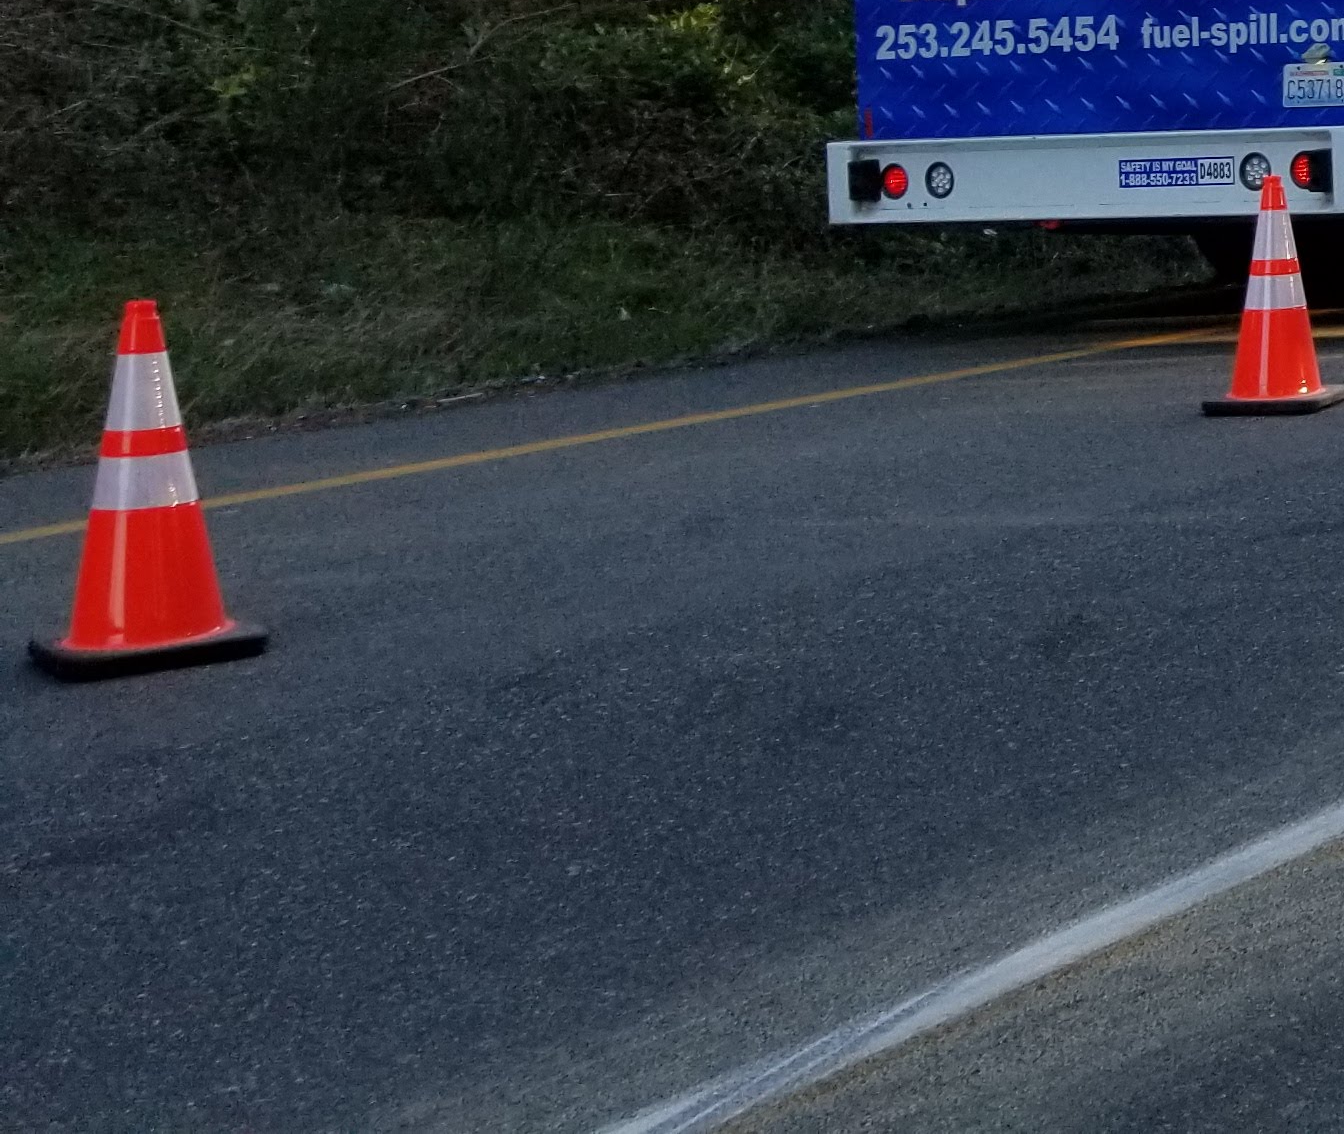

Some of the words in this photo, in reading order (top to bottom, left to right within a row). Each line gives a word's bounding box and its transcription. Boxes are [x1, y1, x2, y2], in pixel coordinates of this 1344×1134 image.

[876, 15, 1118, 60] 253.245.5454
[1120, 162, 1150, 172] SAFETY
[1152, 162, 1160, 171] IS
[1162, 161, 1174, 171] MY
[1175, 161, 1197, 171] GOAL
[1120, 173, 1197, 185] 1-888-550-7233
